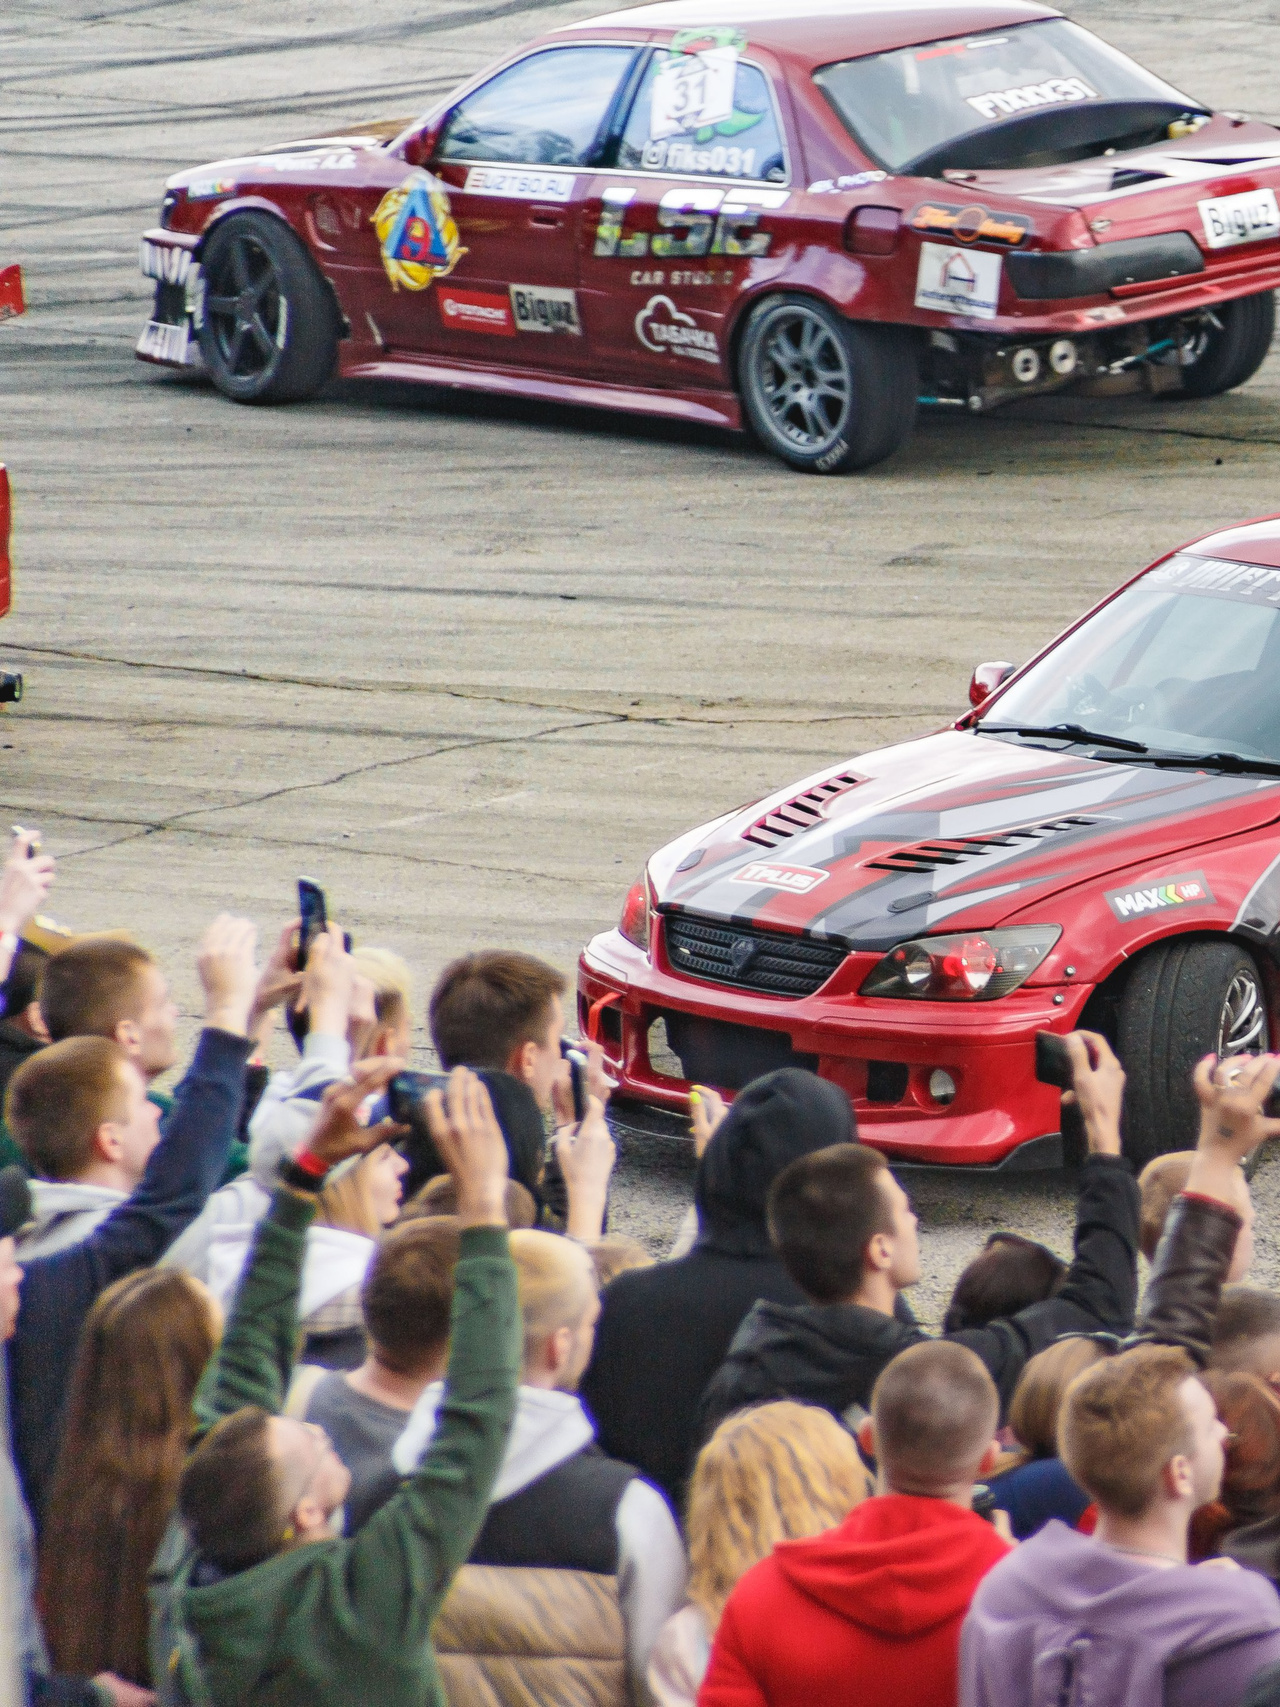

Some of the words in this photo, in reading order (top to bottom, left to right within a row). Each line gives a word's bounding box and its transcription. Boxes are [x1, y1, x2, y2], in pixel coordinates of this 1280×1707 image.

[673, 75, 708, 112] 31
[630, 271, 665, 285] CAR
[1114, 888, 1167, 916] MAX
[1180, 883, 1201, 898] HP
